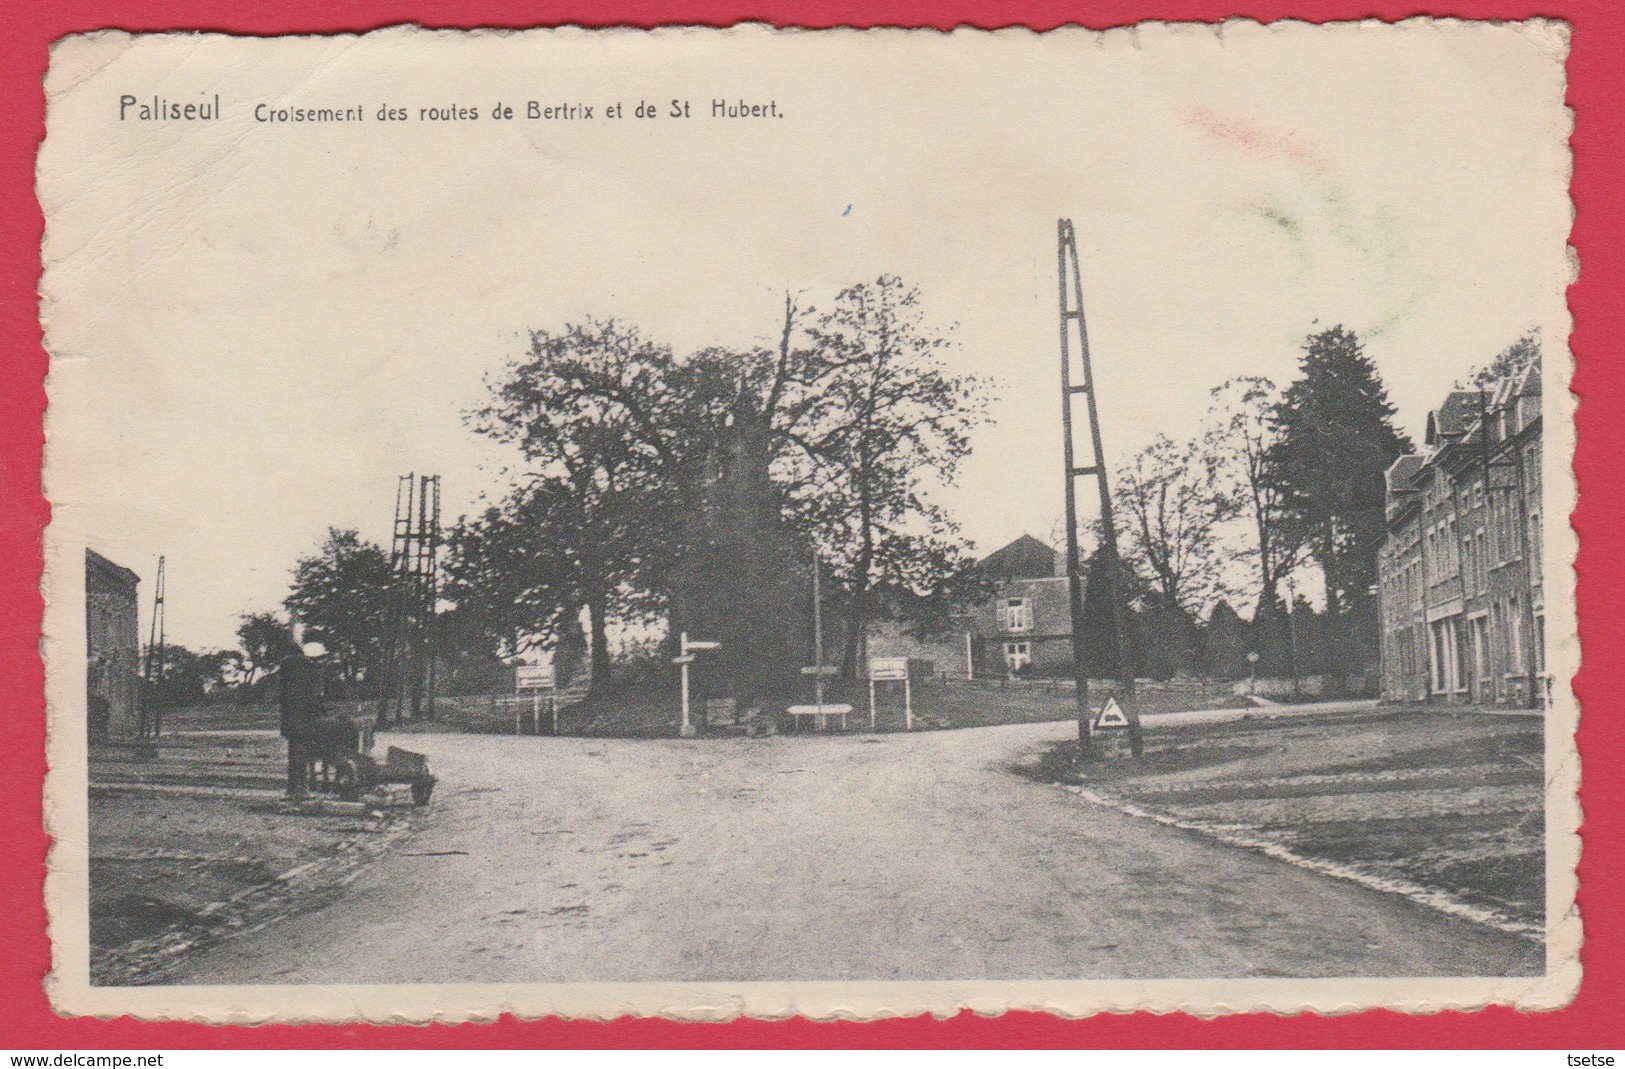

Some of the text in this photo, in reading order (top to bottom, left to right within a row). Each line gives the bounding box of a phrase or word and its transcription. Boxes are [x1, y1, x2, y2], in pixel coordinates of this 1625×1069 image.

[119, 94, 220, 121] Paliseul
[254, 99, 784, 123] Croisement des routes de Bertrix et de St Hubert.
